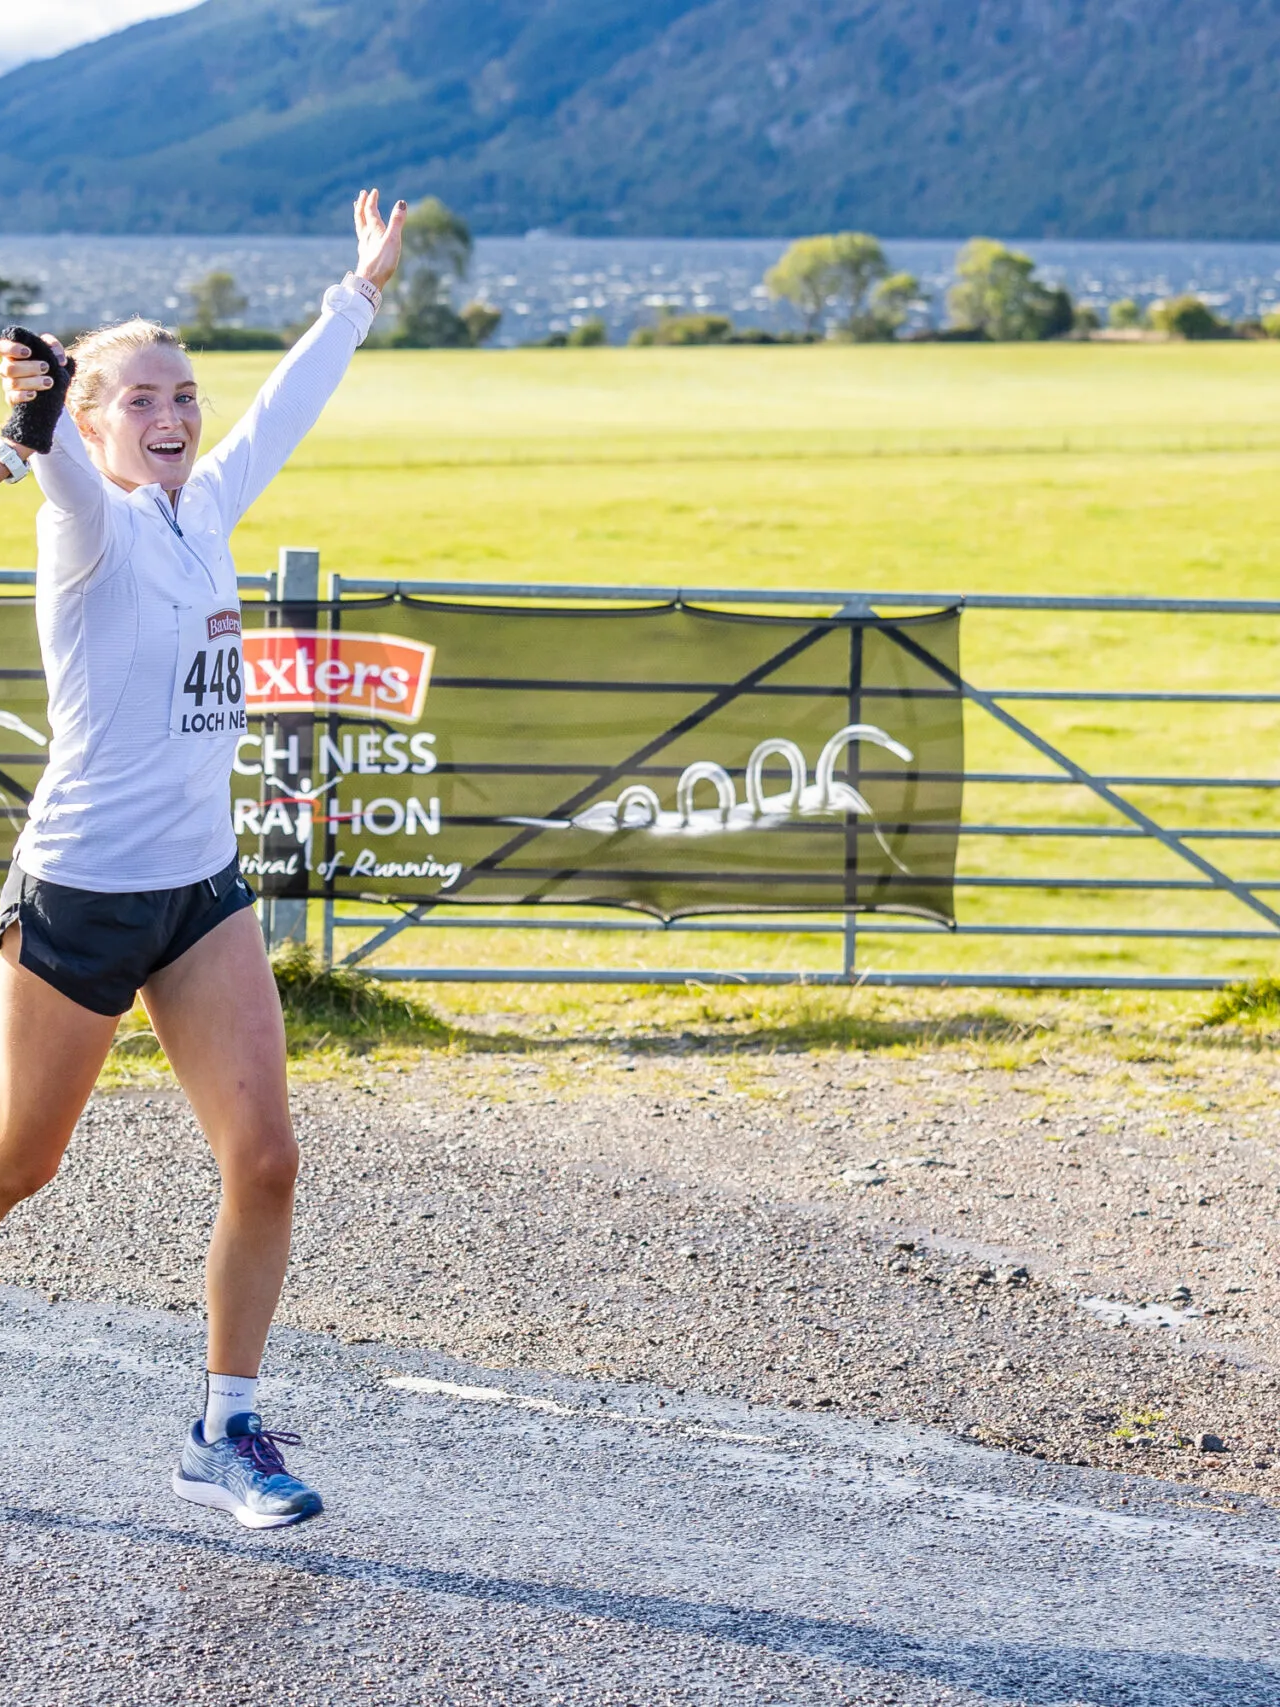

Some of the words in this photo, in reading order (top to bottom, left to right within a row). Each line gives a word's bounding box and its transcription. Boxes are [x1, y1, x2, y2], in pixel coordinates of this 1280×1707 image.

[183, 646, 241, 707] 448
[243, 647, 410, 704] xters
[181, 711, 224, 733] LOCH
[229, 709, 248, 730] NE
[233, 733, 299, 776] CH
[319, 732, 438, 775] NESS
[233, 796, 441, 836] RATHON
[317, 851, 344, 881] of
[350, 848, 462, 887] Running
